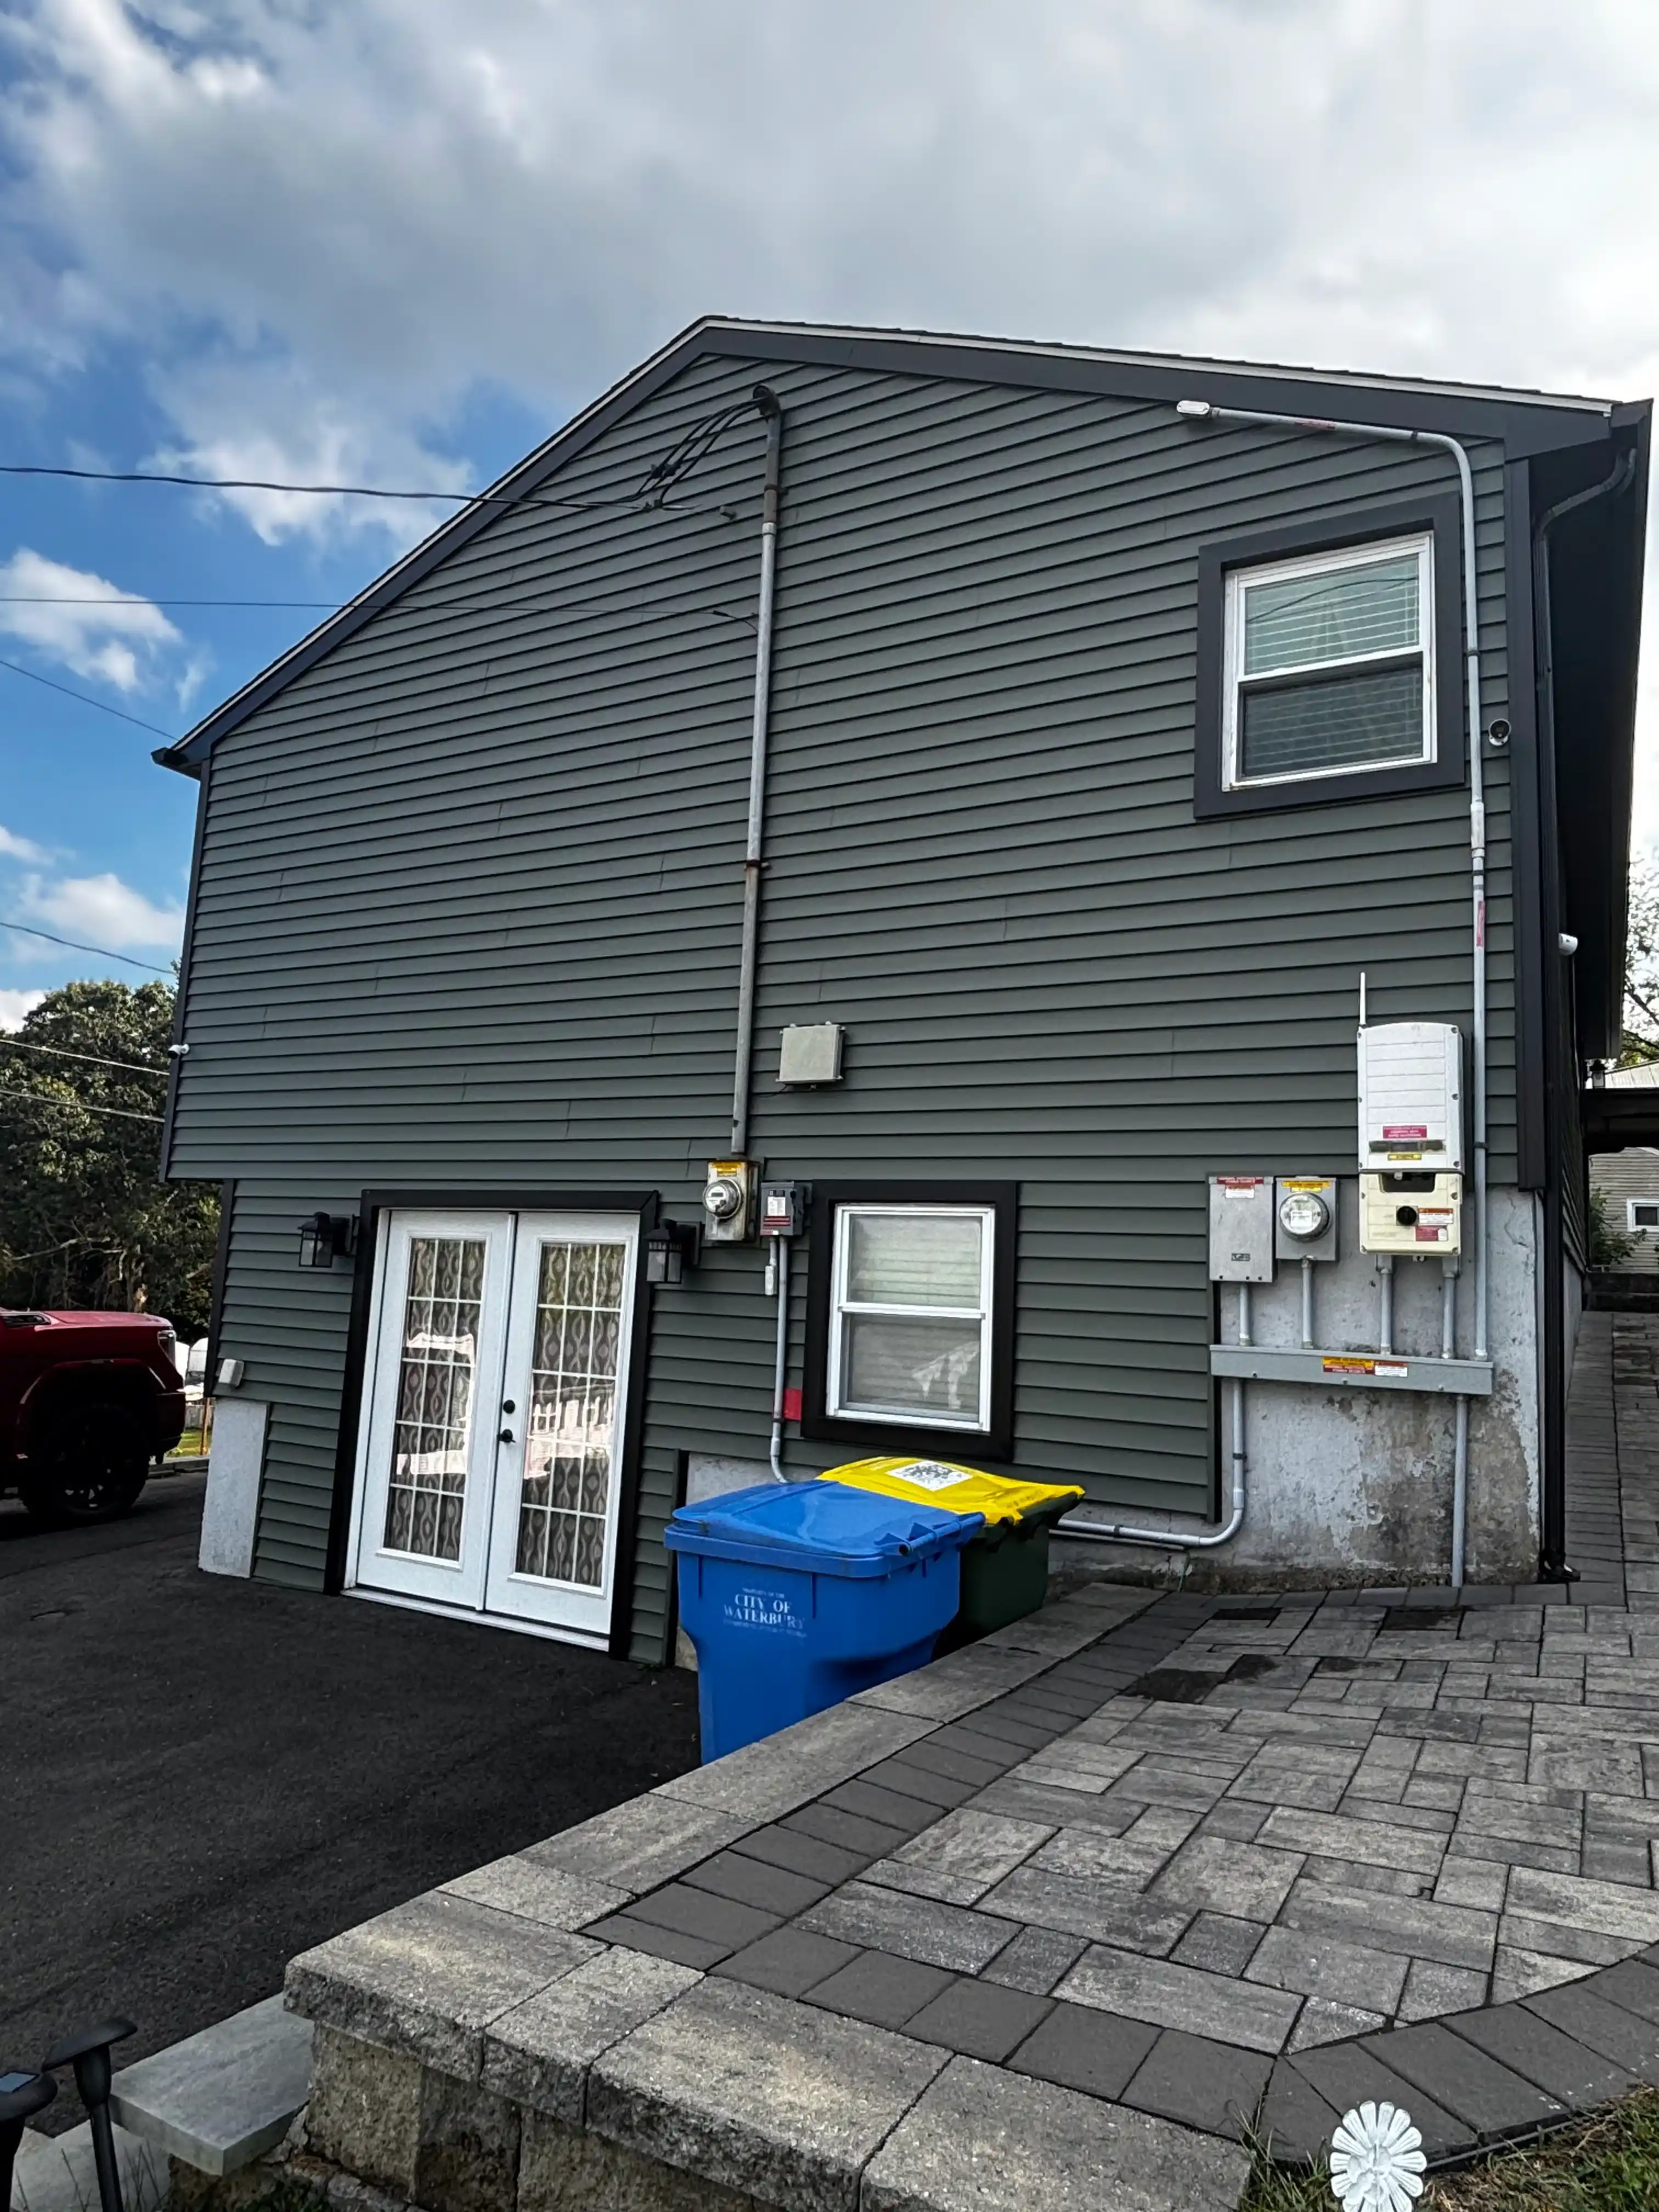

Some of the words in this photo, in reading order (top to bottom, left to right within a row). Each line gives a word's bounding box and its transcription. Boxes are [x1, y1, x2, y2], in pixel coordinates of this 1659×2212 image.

[735, 1594, 766, 1610] CITY
[772, 1599, 792, 1613] OF
[724, 1604, 805, 1630] WATERBURY
